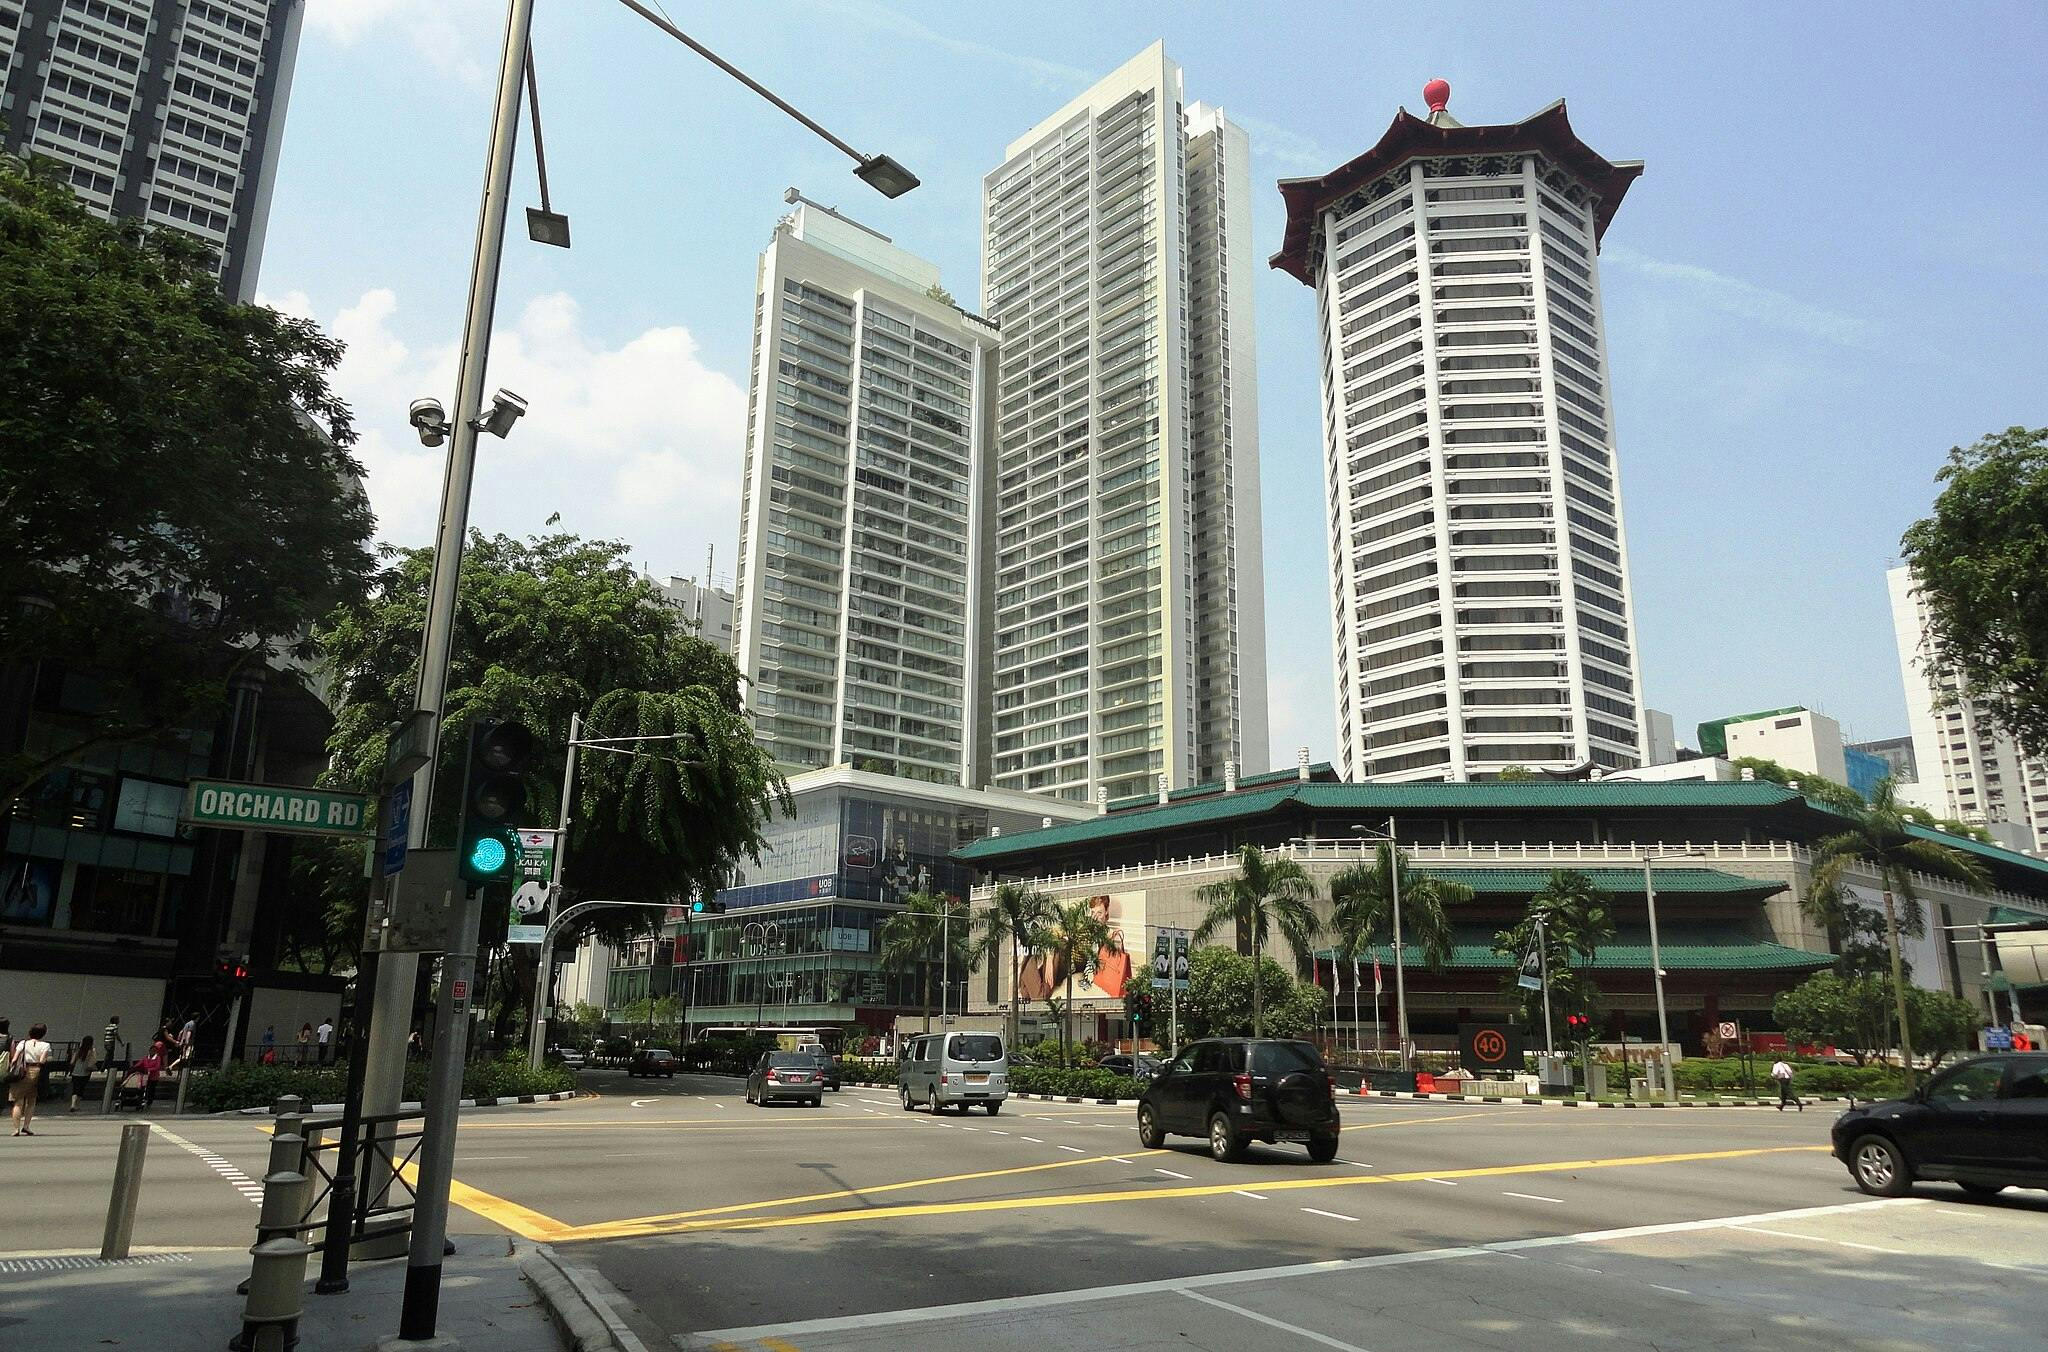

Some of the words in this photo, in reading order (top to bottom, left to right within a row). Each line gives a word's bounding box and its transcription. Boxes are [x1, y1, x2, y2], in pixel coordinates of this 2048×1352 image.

[201, 789, 321, 823] ORCHARD
[327, 802, 359, 826] RD
[819, 879, 832, 888] UOB
[1480, 1037, 1500, 1053] 40
